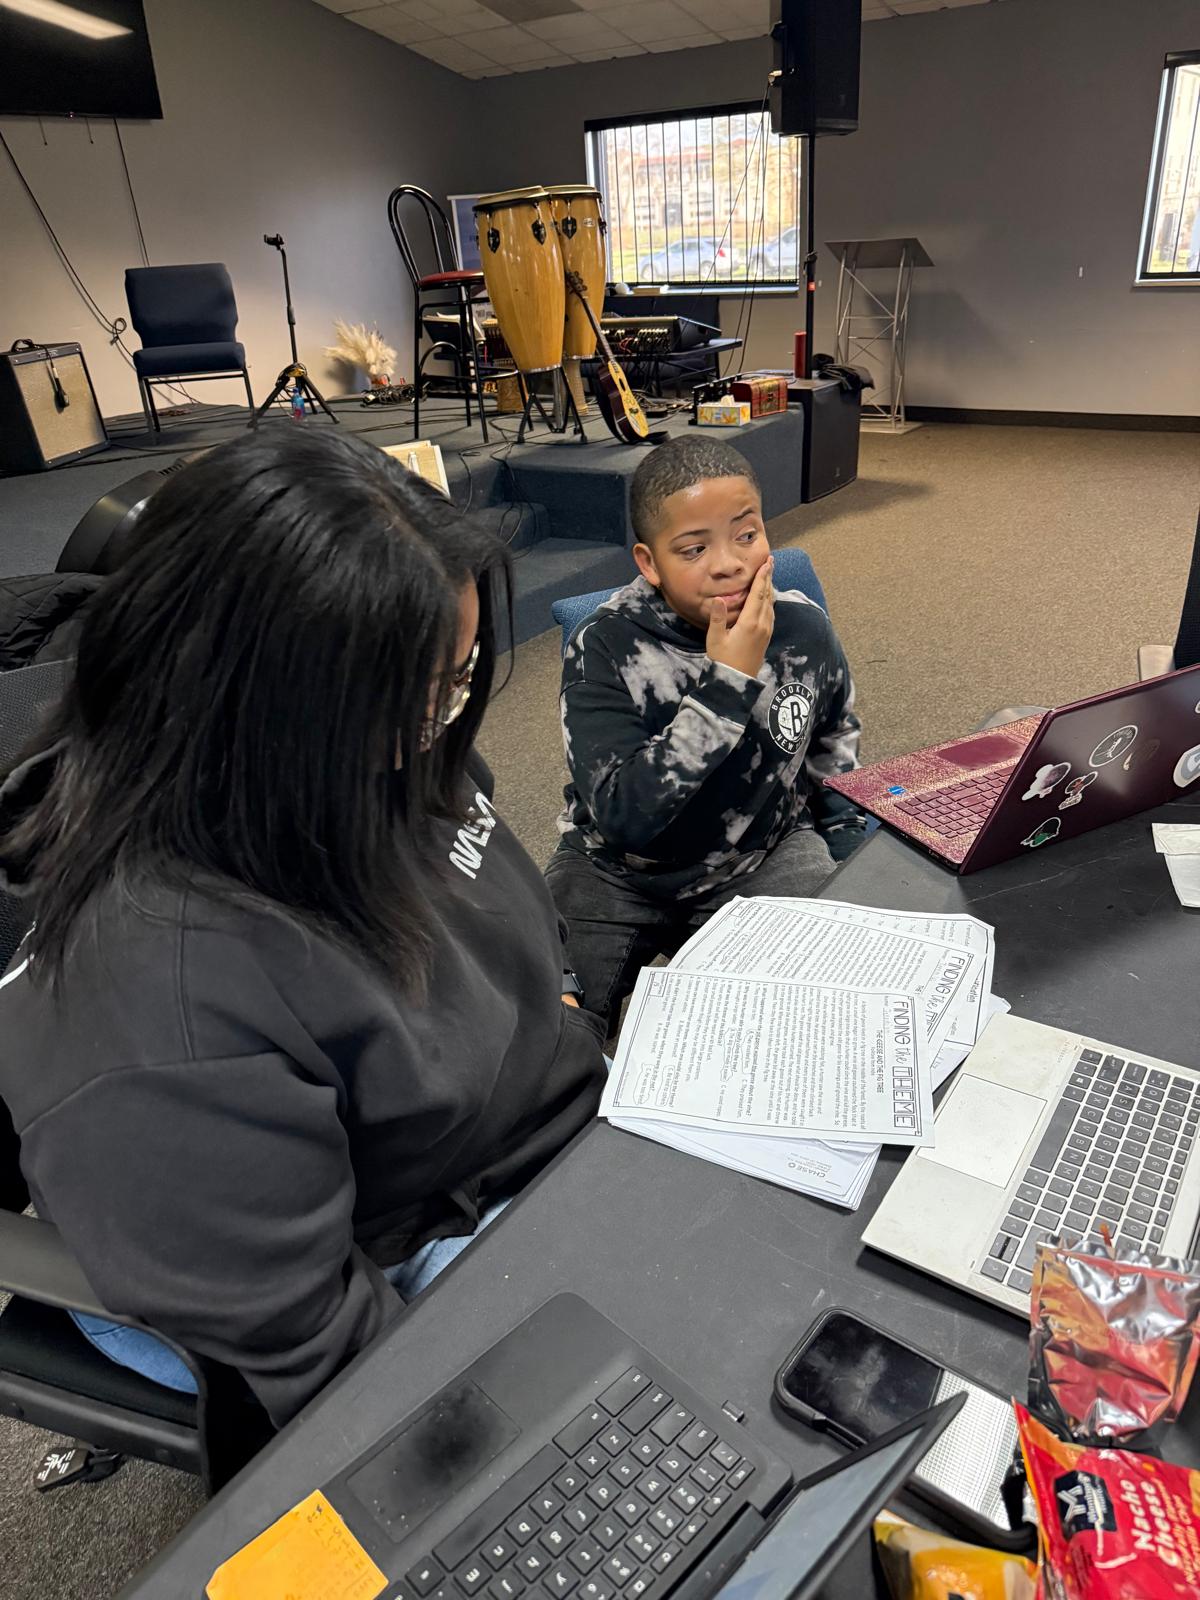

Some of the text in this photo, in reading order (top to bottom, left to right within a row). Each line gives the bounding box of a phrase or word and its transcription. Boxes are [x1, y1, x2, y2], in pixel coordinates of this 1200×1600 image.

[771, 686, 813, 710] BROOKLY
[790, 702, 802, 736] B
[776, 734, 794, 750] NEW
[936, 956, 965, 995] FINDING
[927, 994, 947, 1009] the
[893, 1000, 914, 1127] FINDING the THEME
[588, 1456, 597, 1464] x
[667, 1460, 678, 1468] q
[621, 1466, 630, 1474] s
[648, 1481, 659, 1491] w
[599, 1488, 608, 1498] d
[544, 1500, 552, 1508] v
[626, 1504, 636, 1512] e
[657, 1510, 666, 1518] 3
[1120, 1480, 1156, 1552] Nacho
[519, 1522, 530, 1532] b
[1140, 1481, 1179, 1566] Cheese
[550, 1531, 562, 1543] g
[635, 1534, 643, 1543] 4
[493, 1545, 504, 1556] n
[527, 1556, 540, 1568] h
[612, 1558, 621, 1567] 5
[465, 1568, 480, 1582] m
[556, 1572, 567, 1586] y
[588, 1584, 597, 1592] 6
